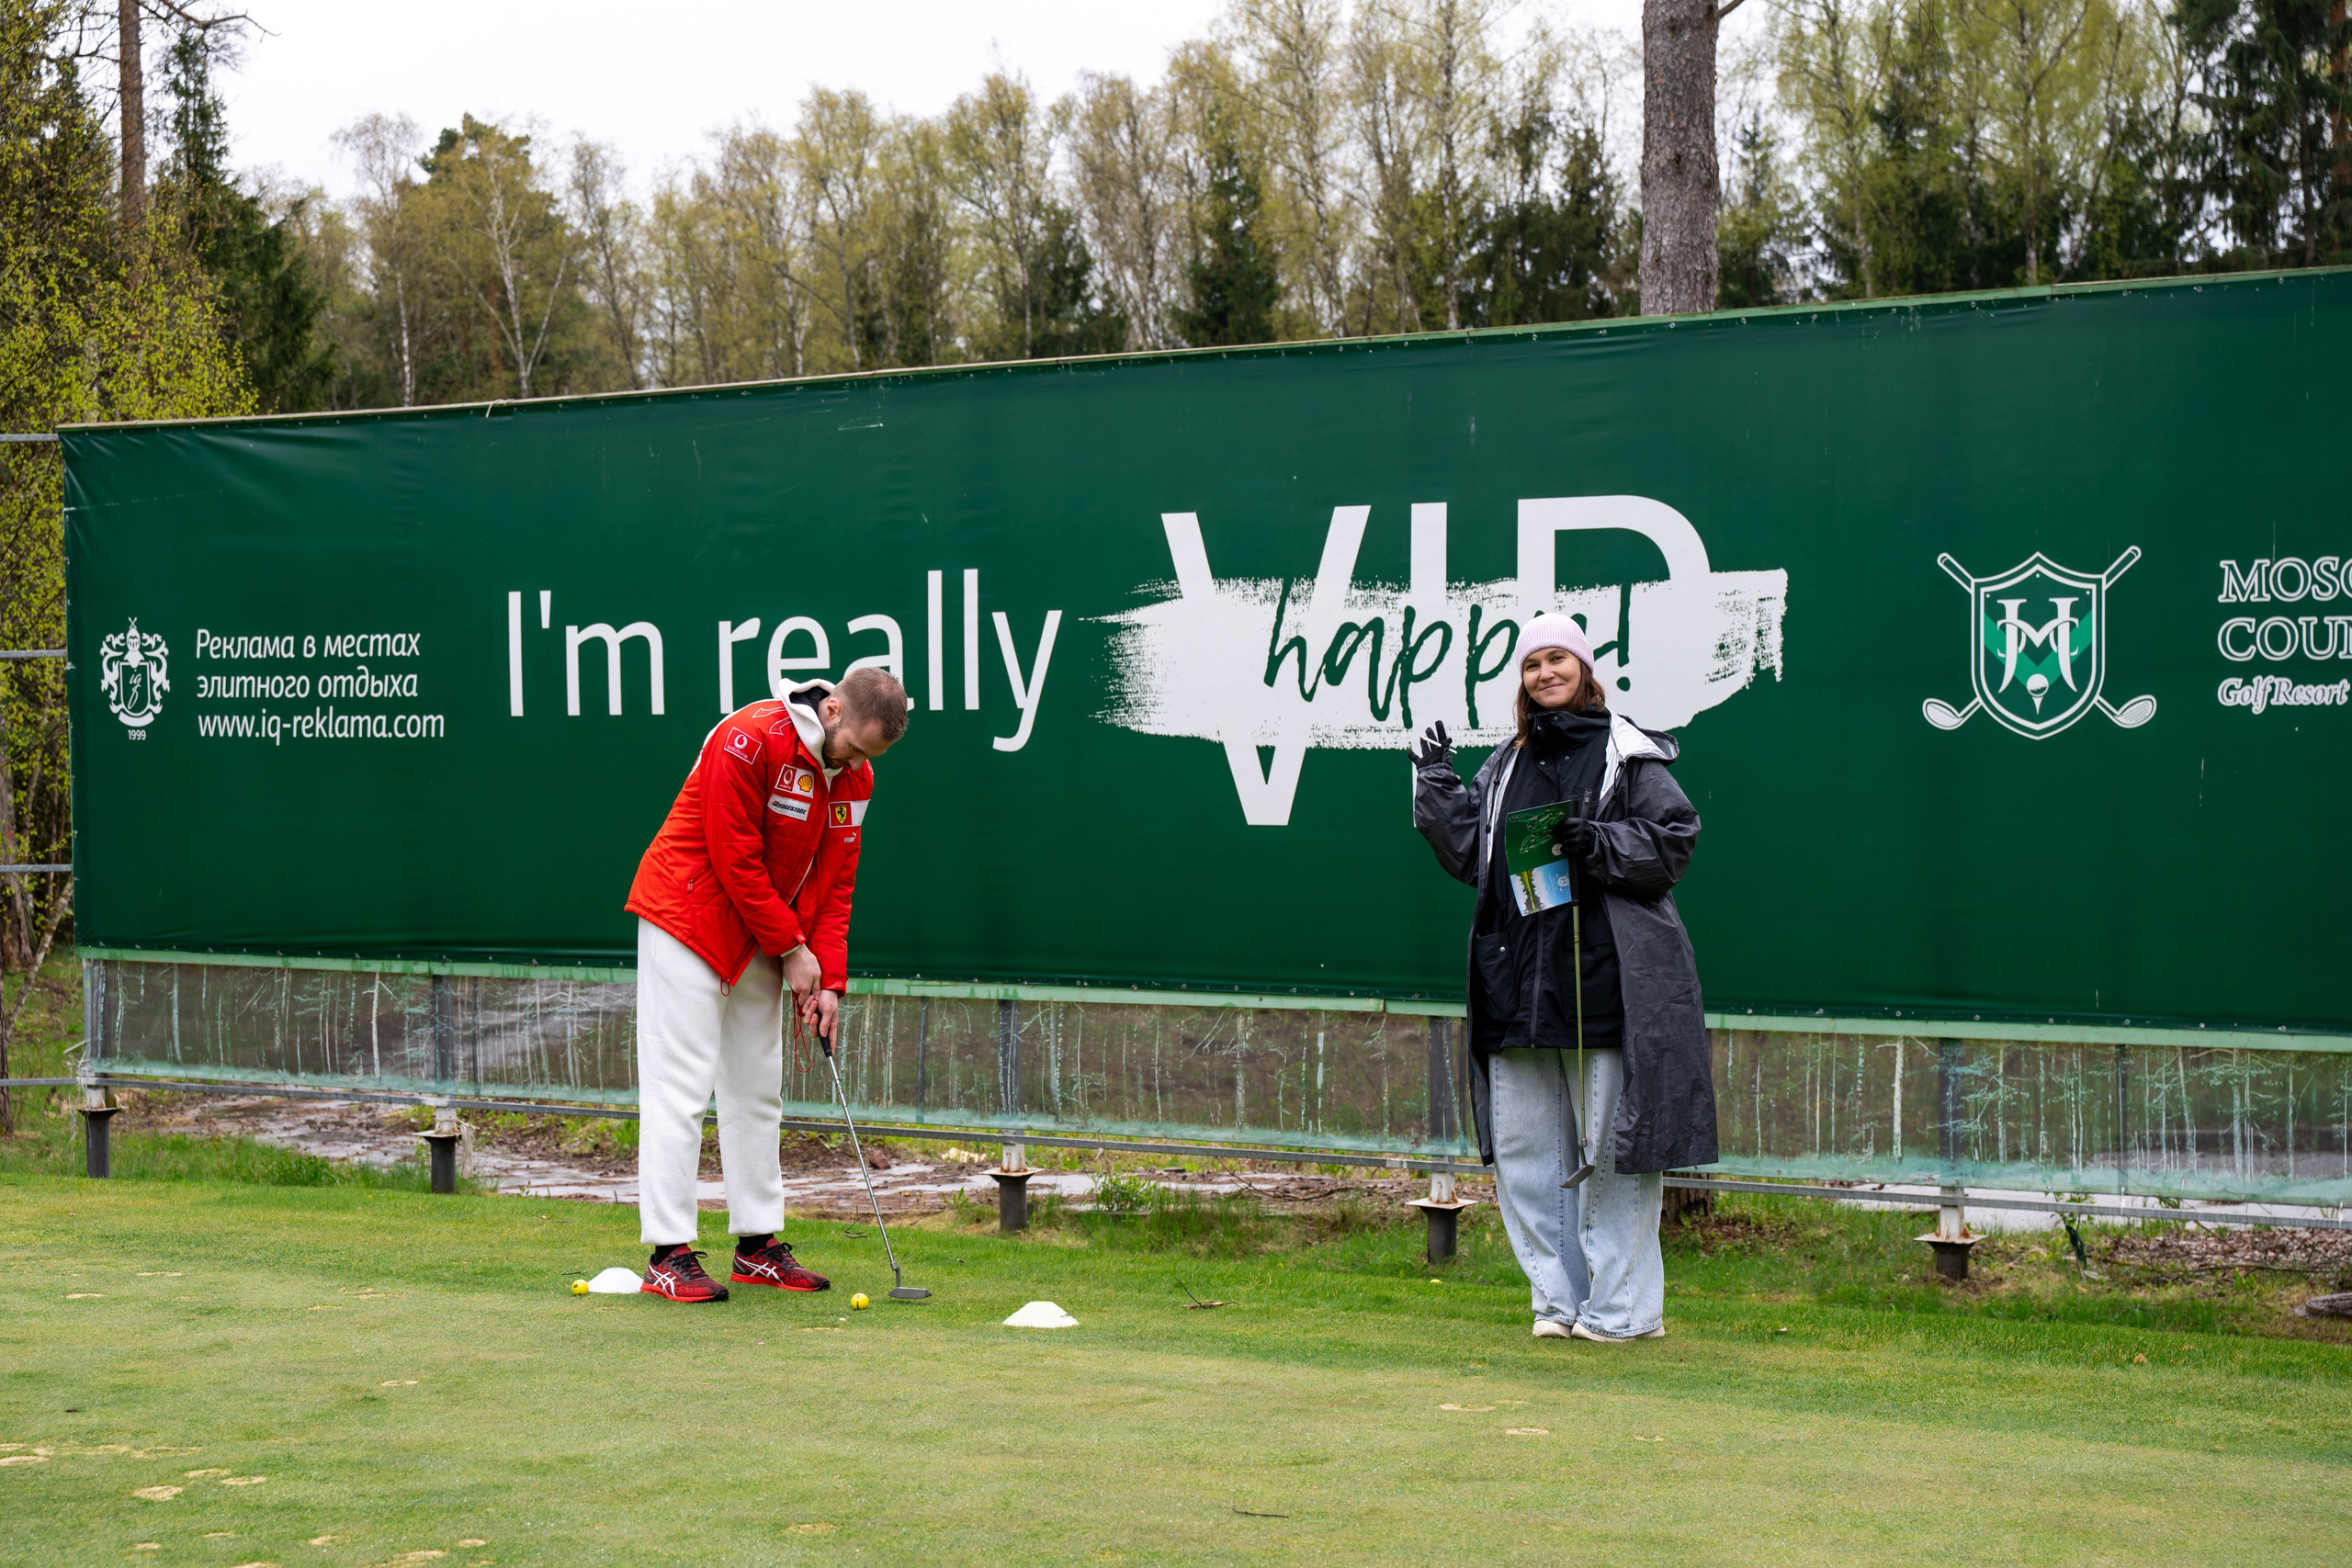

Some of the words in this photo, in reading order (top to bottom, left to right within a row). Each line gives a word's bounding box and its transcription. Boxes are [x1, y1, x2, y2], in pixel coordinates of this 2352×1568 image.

[196, 628, 296, 660] Реклама
[302, 635, 317, 659] в
[323, 632, 421, 658] местах
[507, 590, 665, 717] I'm
[718, 568, 1063, 752] really
[1262, 578, 1632, 730] happ!
[197, 675, 311, 699] элитного
[318, 665, 419, 698] отдыха
[2217, 674, 2275, 716] Golf
[2270, 677, 2351, 706] Resort
[128, 729, 147, 740] 1999
[198, 705, 445, 746] www.iq-reklama.com
